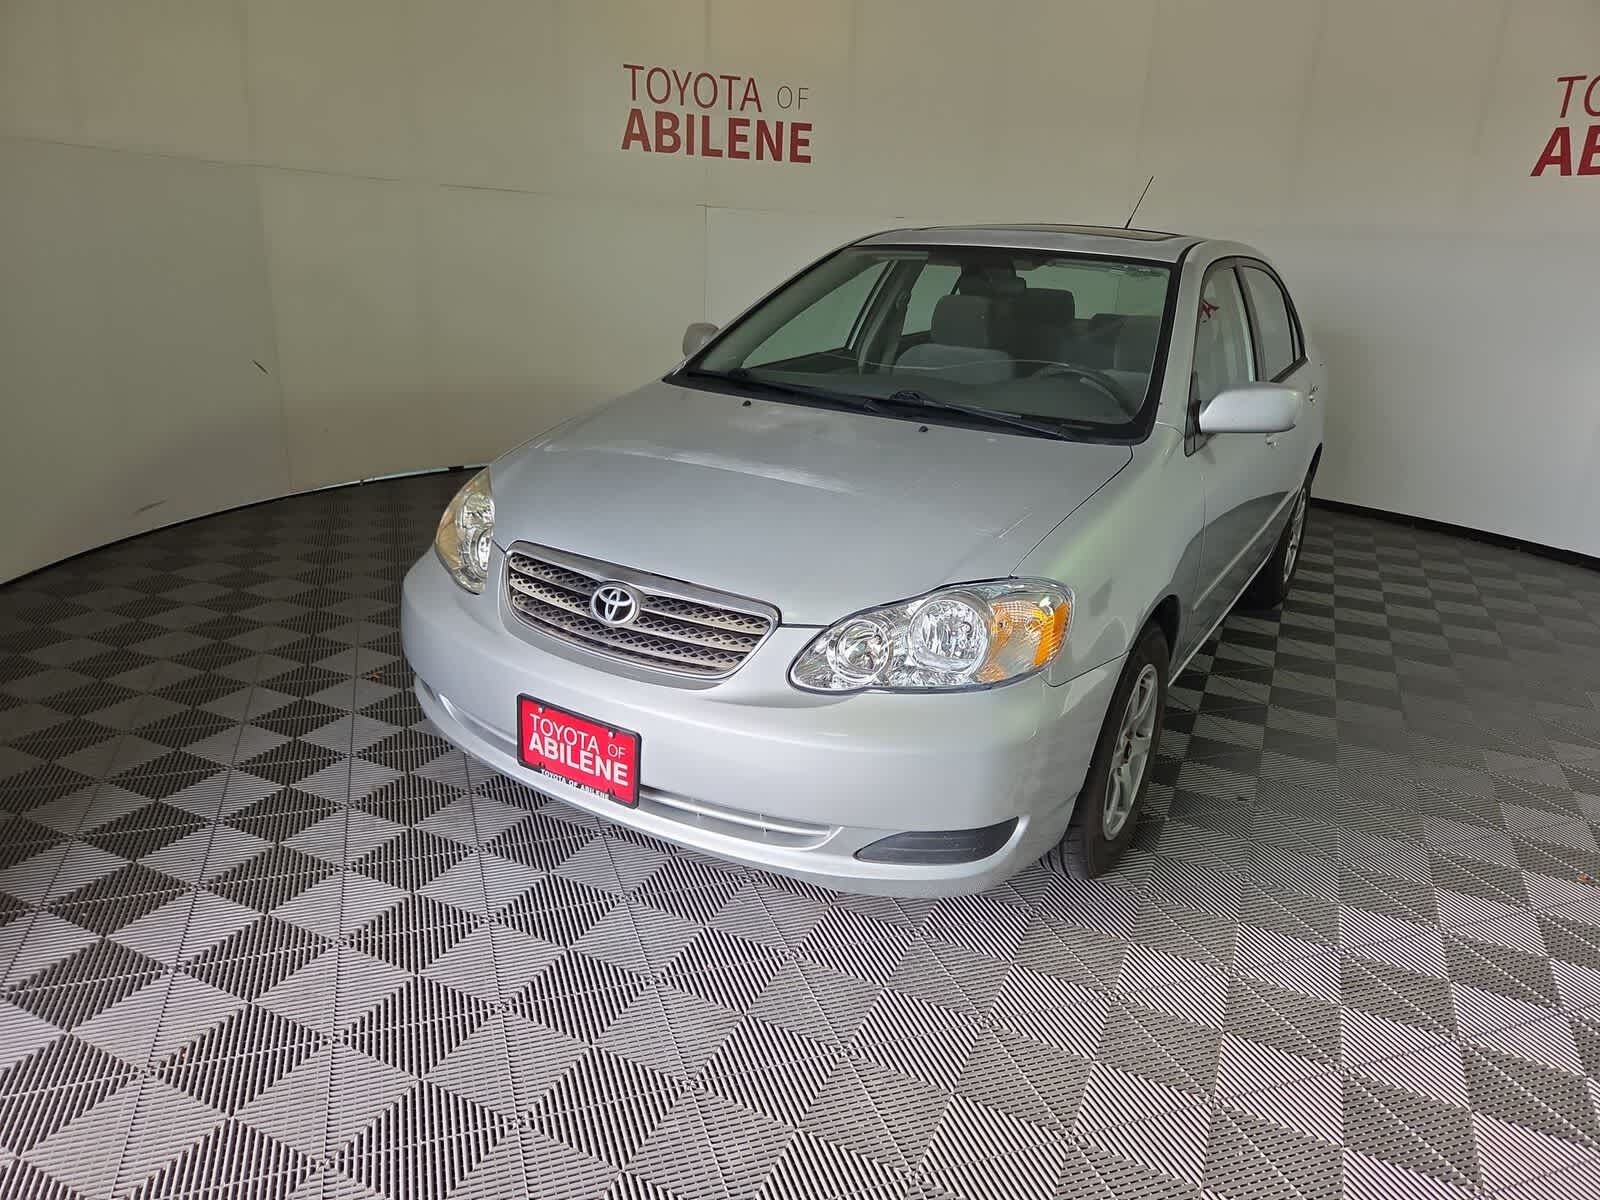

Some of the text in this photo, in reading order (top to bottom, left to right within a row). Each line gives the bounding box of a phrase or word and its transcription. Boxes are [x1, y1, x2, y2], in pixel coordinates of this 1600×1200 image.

[623, 64, 809, 112] TOYOTA OF
[621, 108, 812, 163] ABILENE
[529, 713, 626, 758] TOYOTA OF
[529, 732, 629, 786] ABILENE
[541, 768, 567, 785] TOYOTA
